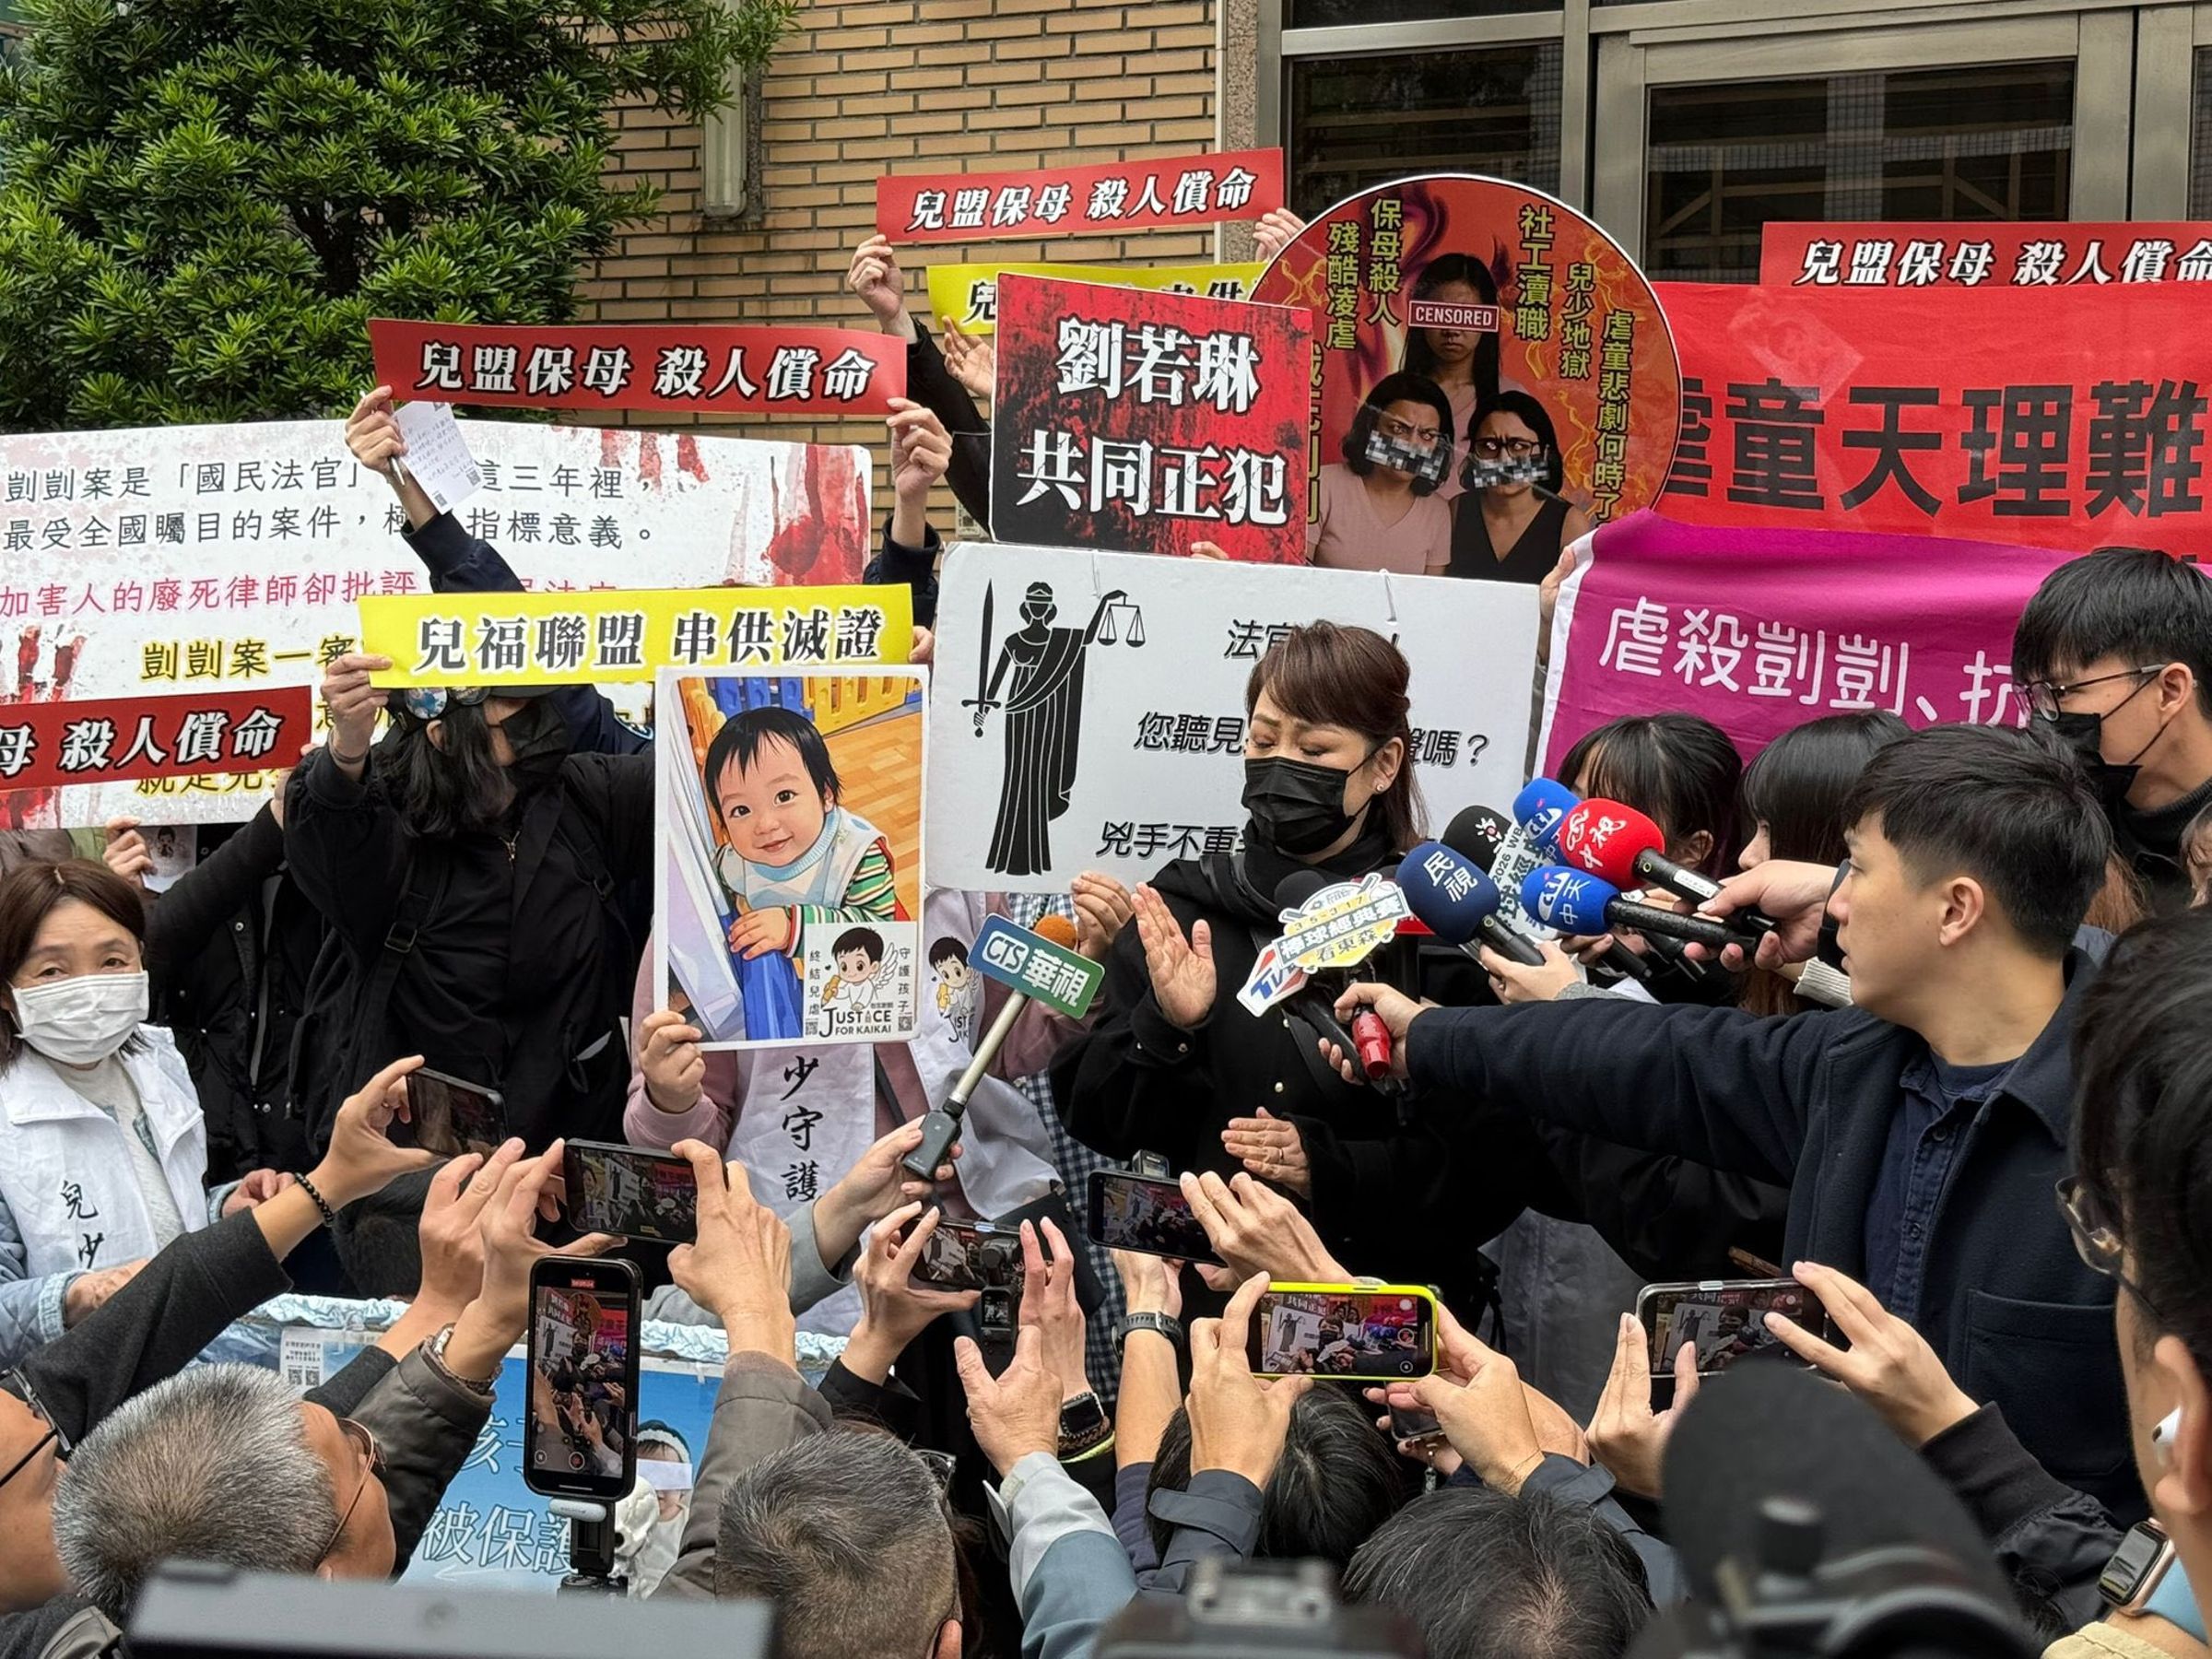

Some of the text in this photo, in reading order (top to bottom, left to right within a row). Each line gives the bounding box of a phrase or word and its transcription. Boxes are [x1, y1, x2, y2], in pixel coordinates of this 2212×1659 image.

[907, 166, 1256, 231] 兒盟保母 殺人償命
[1325, 221, 1360, 351] 殘酷凌虐
[1369, 197, 1403, 325] 保母殺人
[1515, 206, 1555, 341] 社工瀆職
[1796, 241, 2212, 288] 兒盟保母 殺人償命
[1416, 305, 1492, 328] CENSORED
[1560, 264, 1594, 380] 兒少地獄
[418, 343, 874, 400] 兒盟保母 殺人償命
[1055, 318, 1260, 412] 劉若琳
[1594, 311, 1633, 527] 虐童悲劇何時了
[1016, 430, 1288, 524] 共同正犯
[414, 606, 882, 671] 兒福聯盟 串供滅證
[60, 709, 282, 771] 殺人償命
[1095, 820, 1246, 858] 兇手不重
[1494, 853, 1512, 884] 2026
[1423, 851, 1478, 902] 民視
[1559, 878, 1591, 925] 中天
[986, 935, 1026, 970] CTS
[1280, 895, 1403, 959] 棒球經典賽
[1316, 927, 1378, 962] 看東森
[898, 947, 912, 1013] 守護孩子
[1021, 947, 1090, 1007] 華視
[856, 1024, 891, 1034] KAIKAI
[780, 1055, 823, 1202] 少守護
